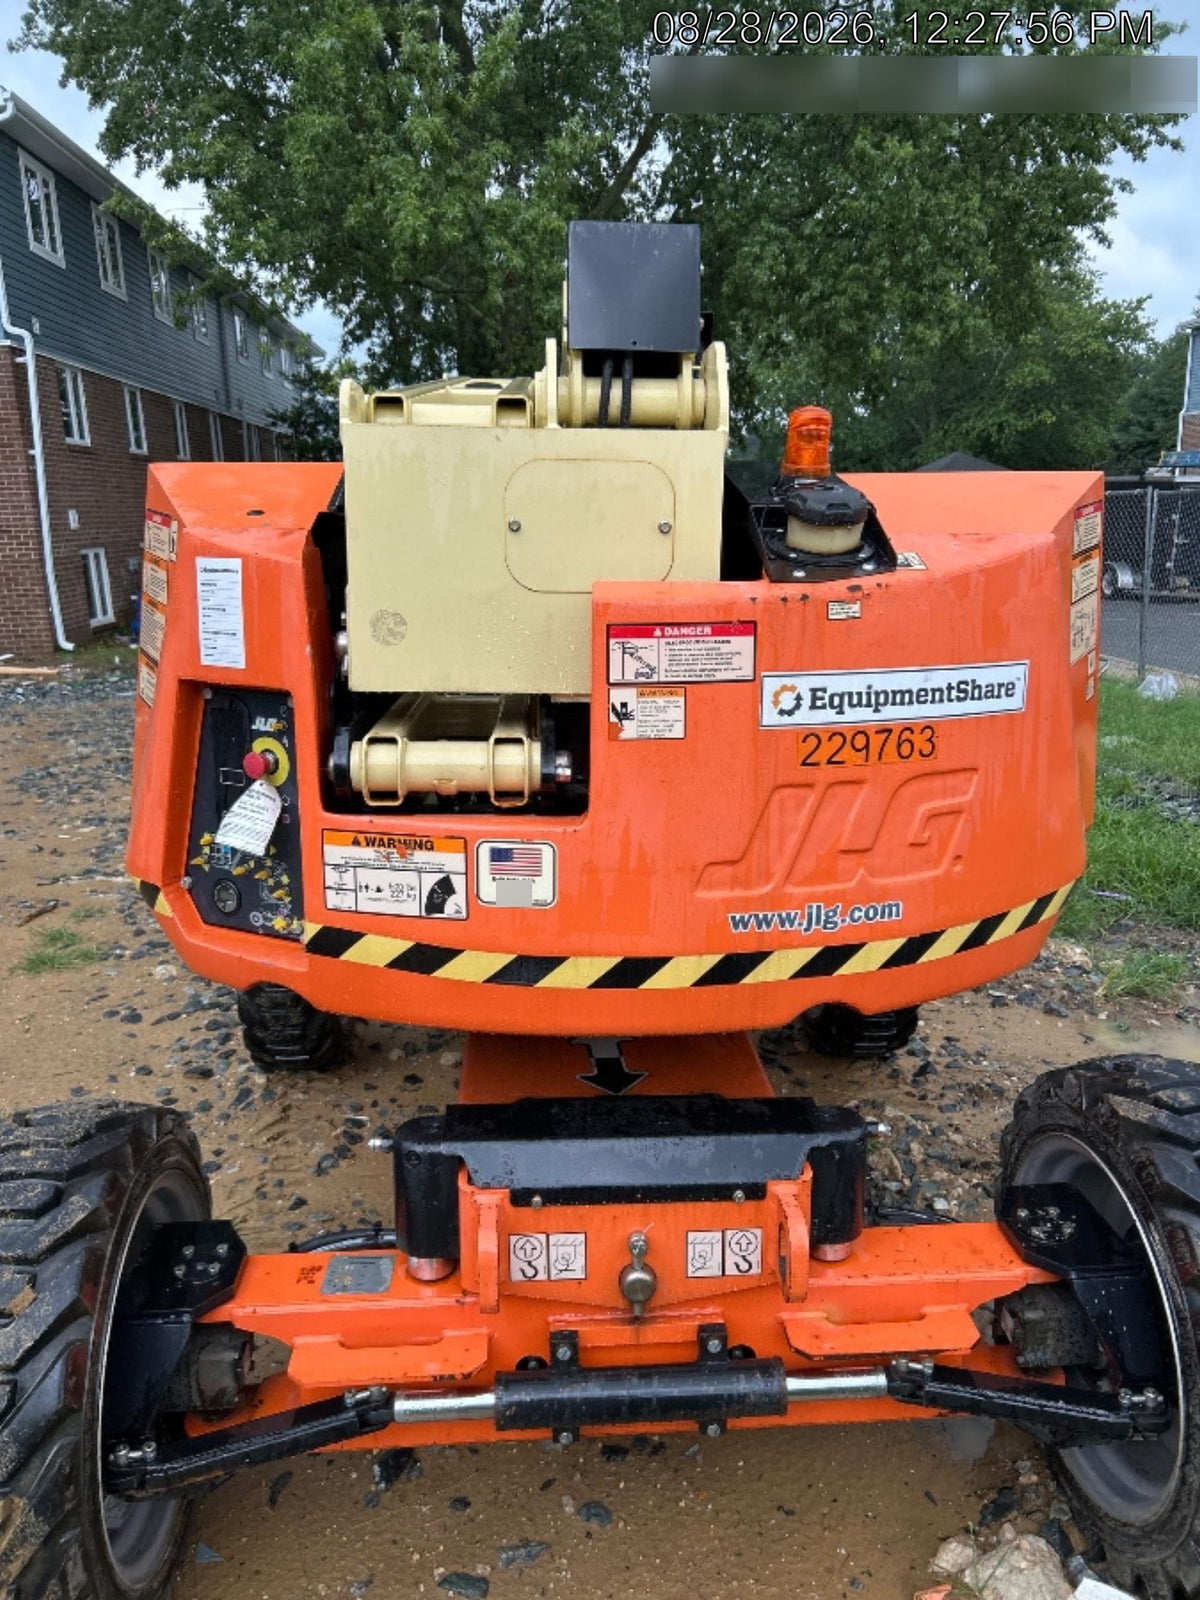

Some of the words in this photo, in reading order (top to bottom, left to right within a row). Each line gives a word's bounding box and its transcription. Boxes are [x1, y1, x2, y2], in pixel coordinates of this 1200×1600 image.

[664, 626, 712, 636] DANGER
[809, 679, 1016, 715] EquipmentShare
[801, 725, 936, 767] 229763
[694, 768, 979, 898] JLG
[729, 901, 902, 933] www.jlg.com
